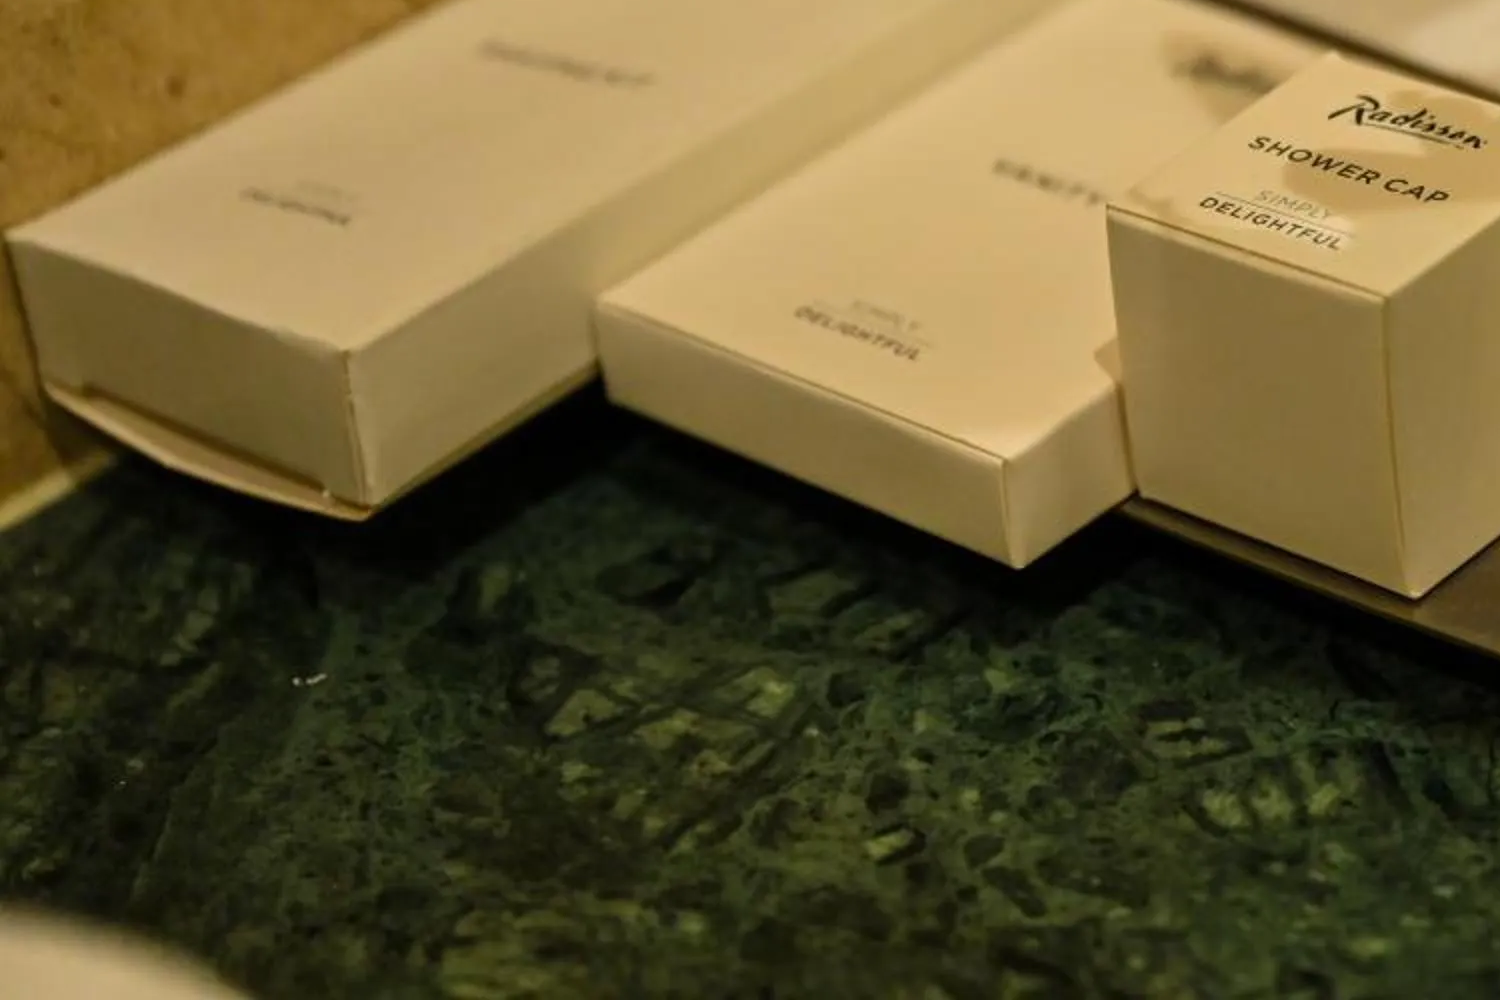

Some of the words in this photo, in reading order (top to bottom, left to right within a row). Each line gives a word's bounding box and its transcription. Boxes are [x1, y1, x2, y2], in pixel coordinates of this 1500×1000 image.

[1327, 94, 1487, 149] Radisson
[1248, 136, 1381, 184] SHOWER
[1383, 178, 1450, 204] CAP
[1199, 197, 1342, 251] DELIGHTFUL
[1259, 189, 1333, 220] SIMPLY
